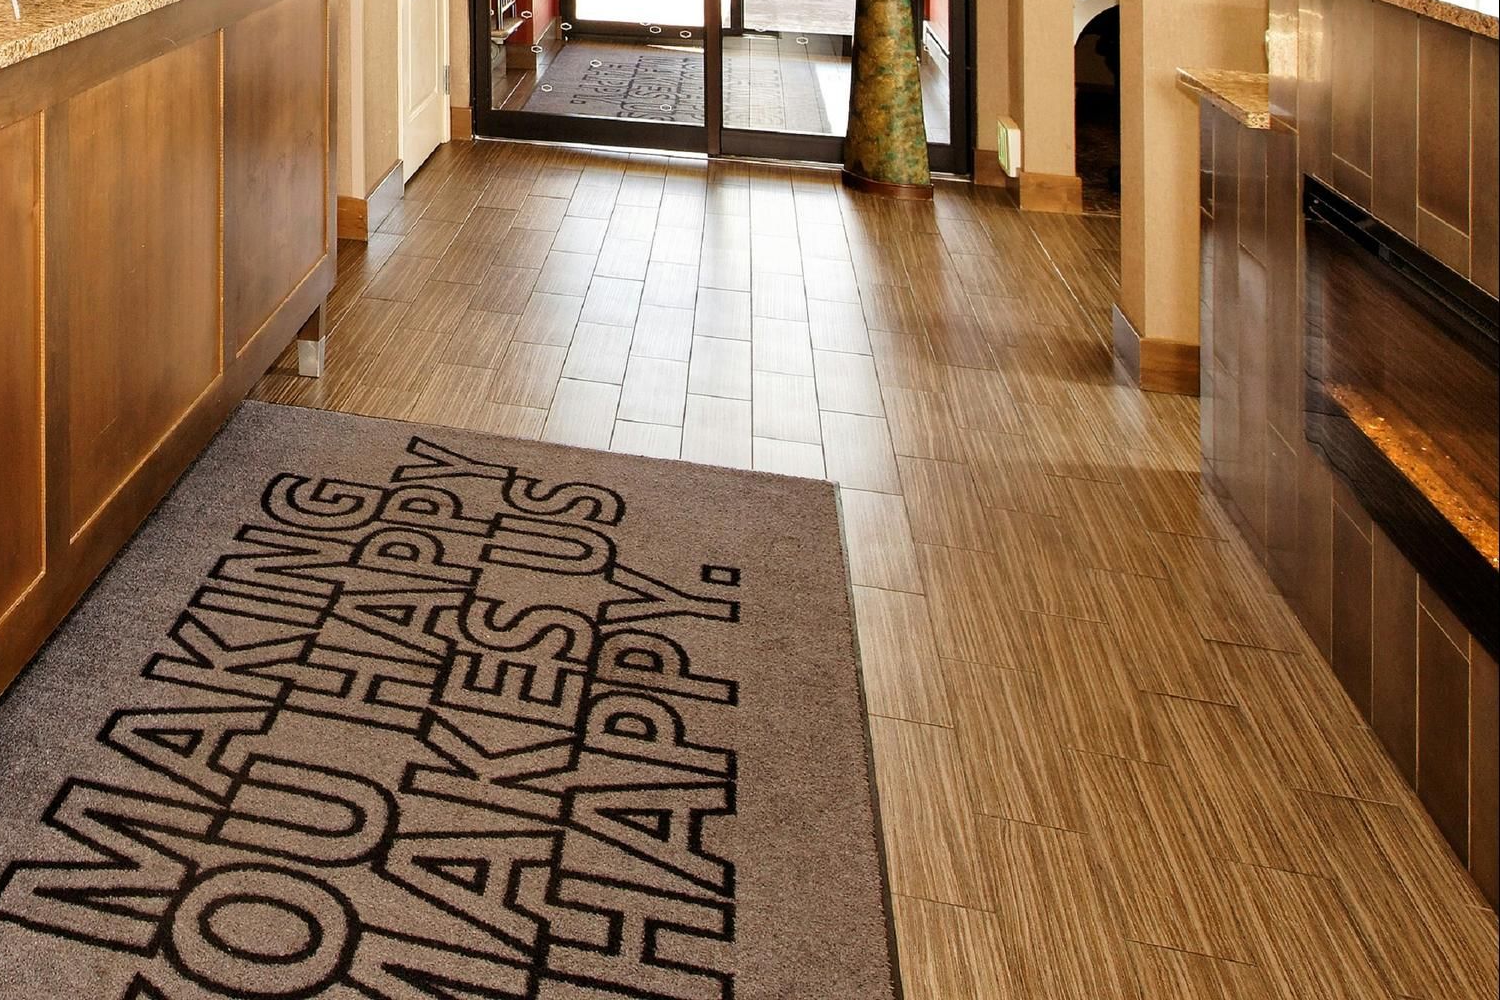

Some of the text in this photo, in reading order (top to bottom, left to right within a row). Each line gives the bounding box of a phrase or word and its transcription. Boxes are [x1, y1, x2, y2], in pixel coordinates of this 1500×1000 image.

[479, 468, 626, 577] US
[122, 436, 516, 1000] OU HAPPY
